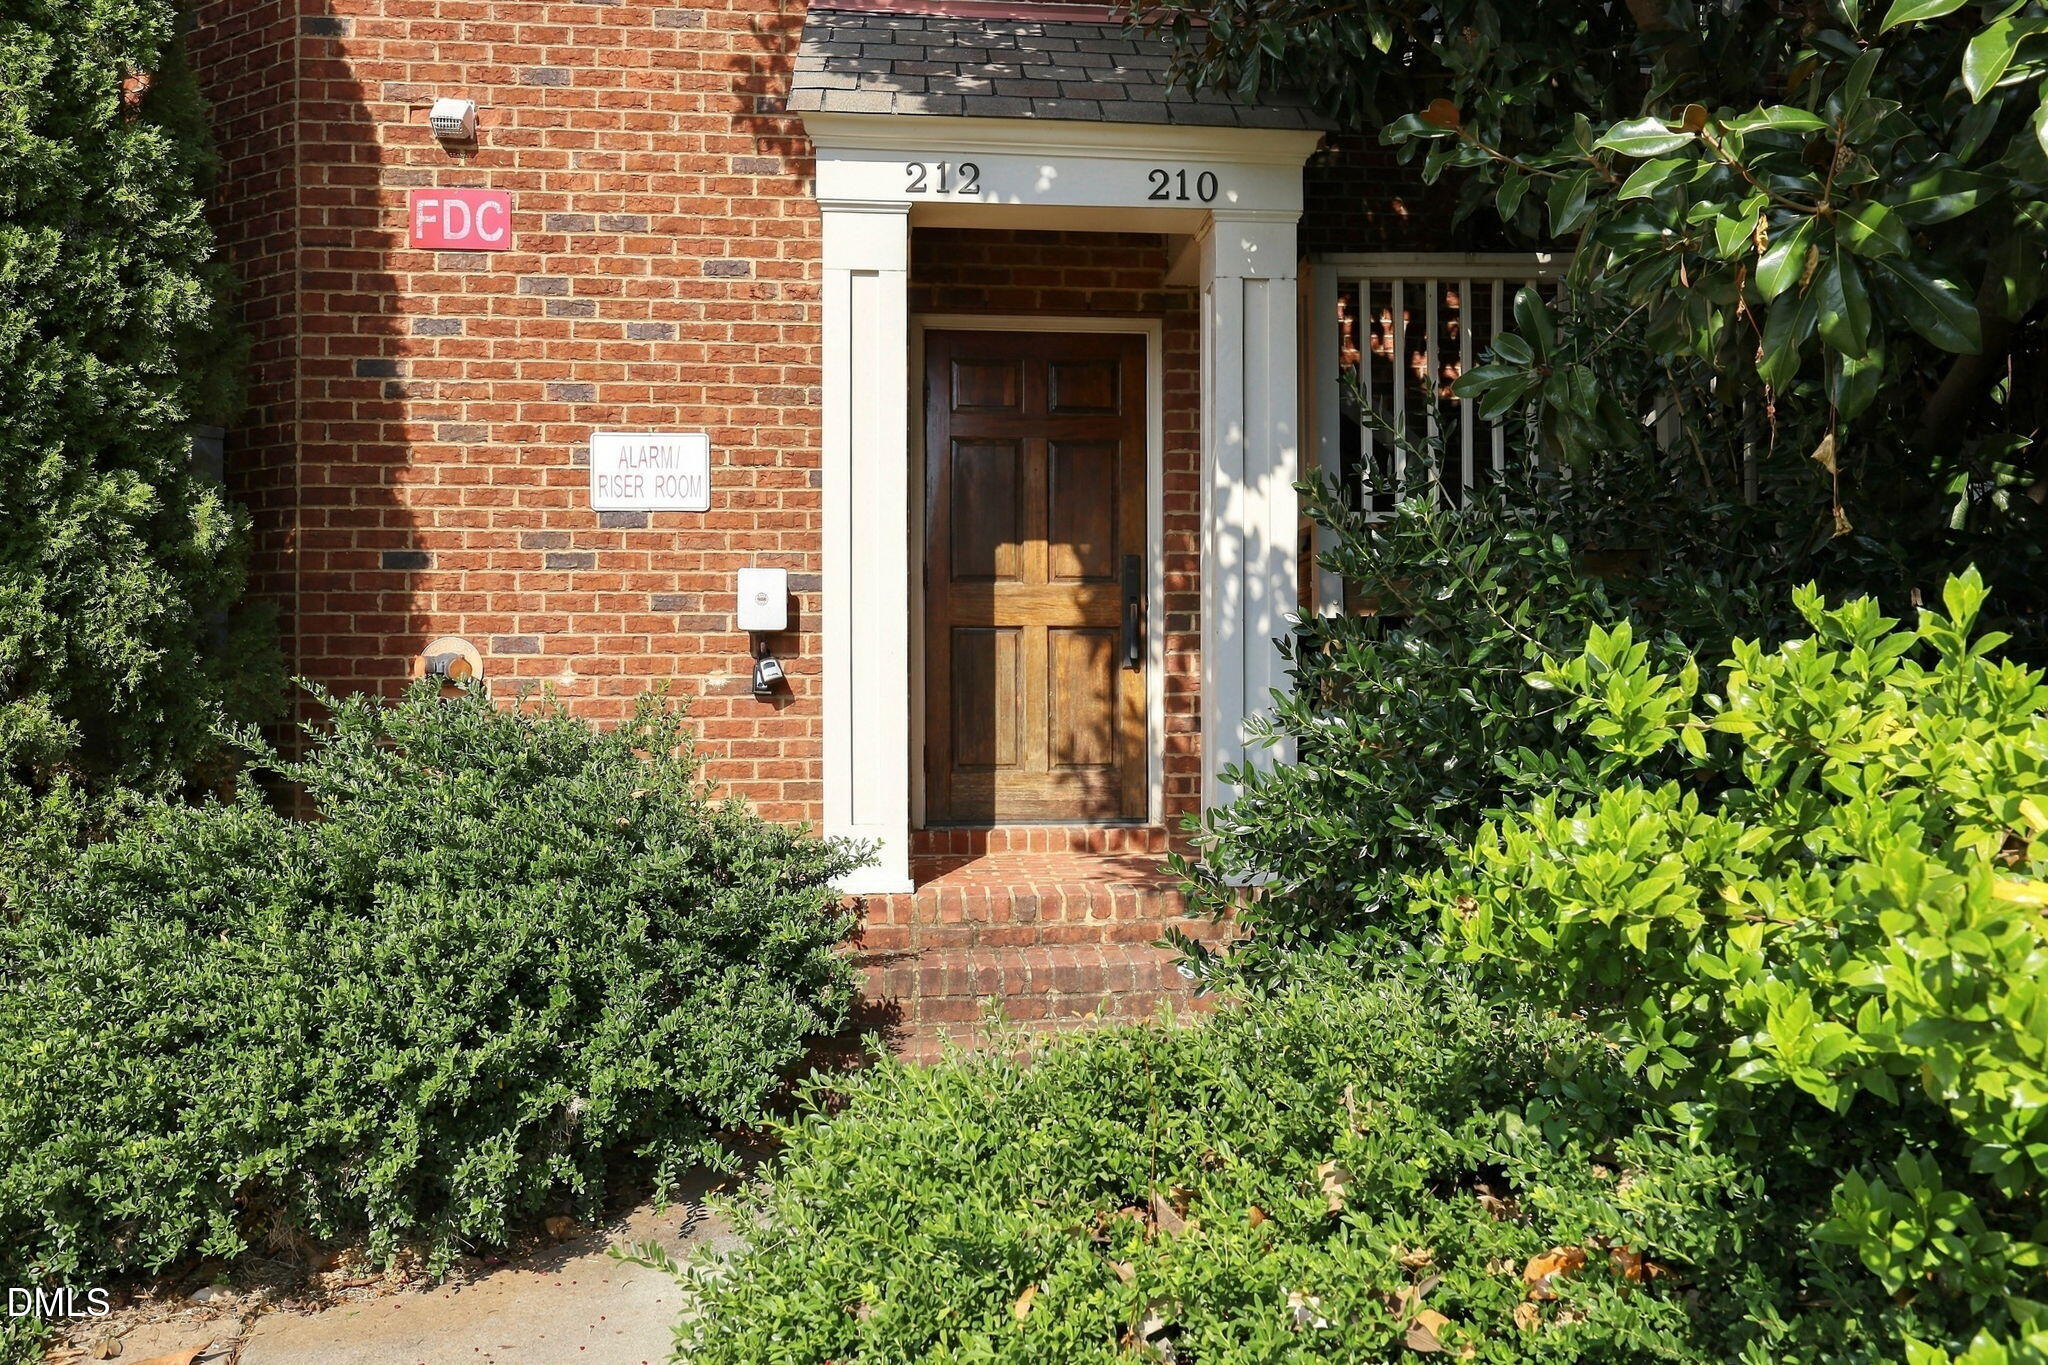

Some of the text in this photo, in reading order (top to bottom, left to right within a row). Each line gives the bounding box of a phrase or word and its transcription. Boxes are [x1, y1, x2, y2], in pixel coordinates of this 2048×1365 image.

[905, 161, 981, 194] 212
[1147, 168, 1219, 202] 210
[415, 199, 504, 242] FDC
[618, 445, 681, 469] ALARM/
[598, 474, 702, 498] RISER ROOM
